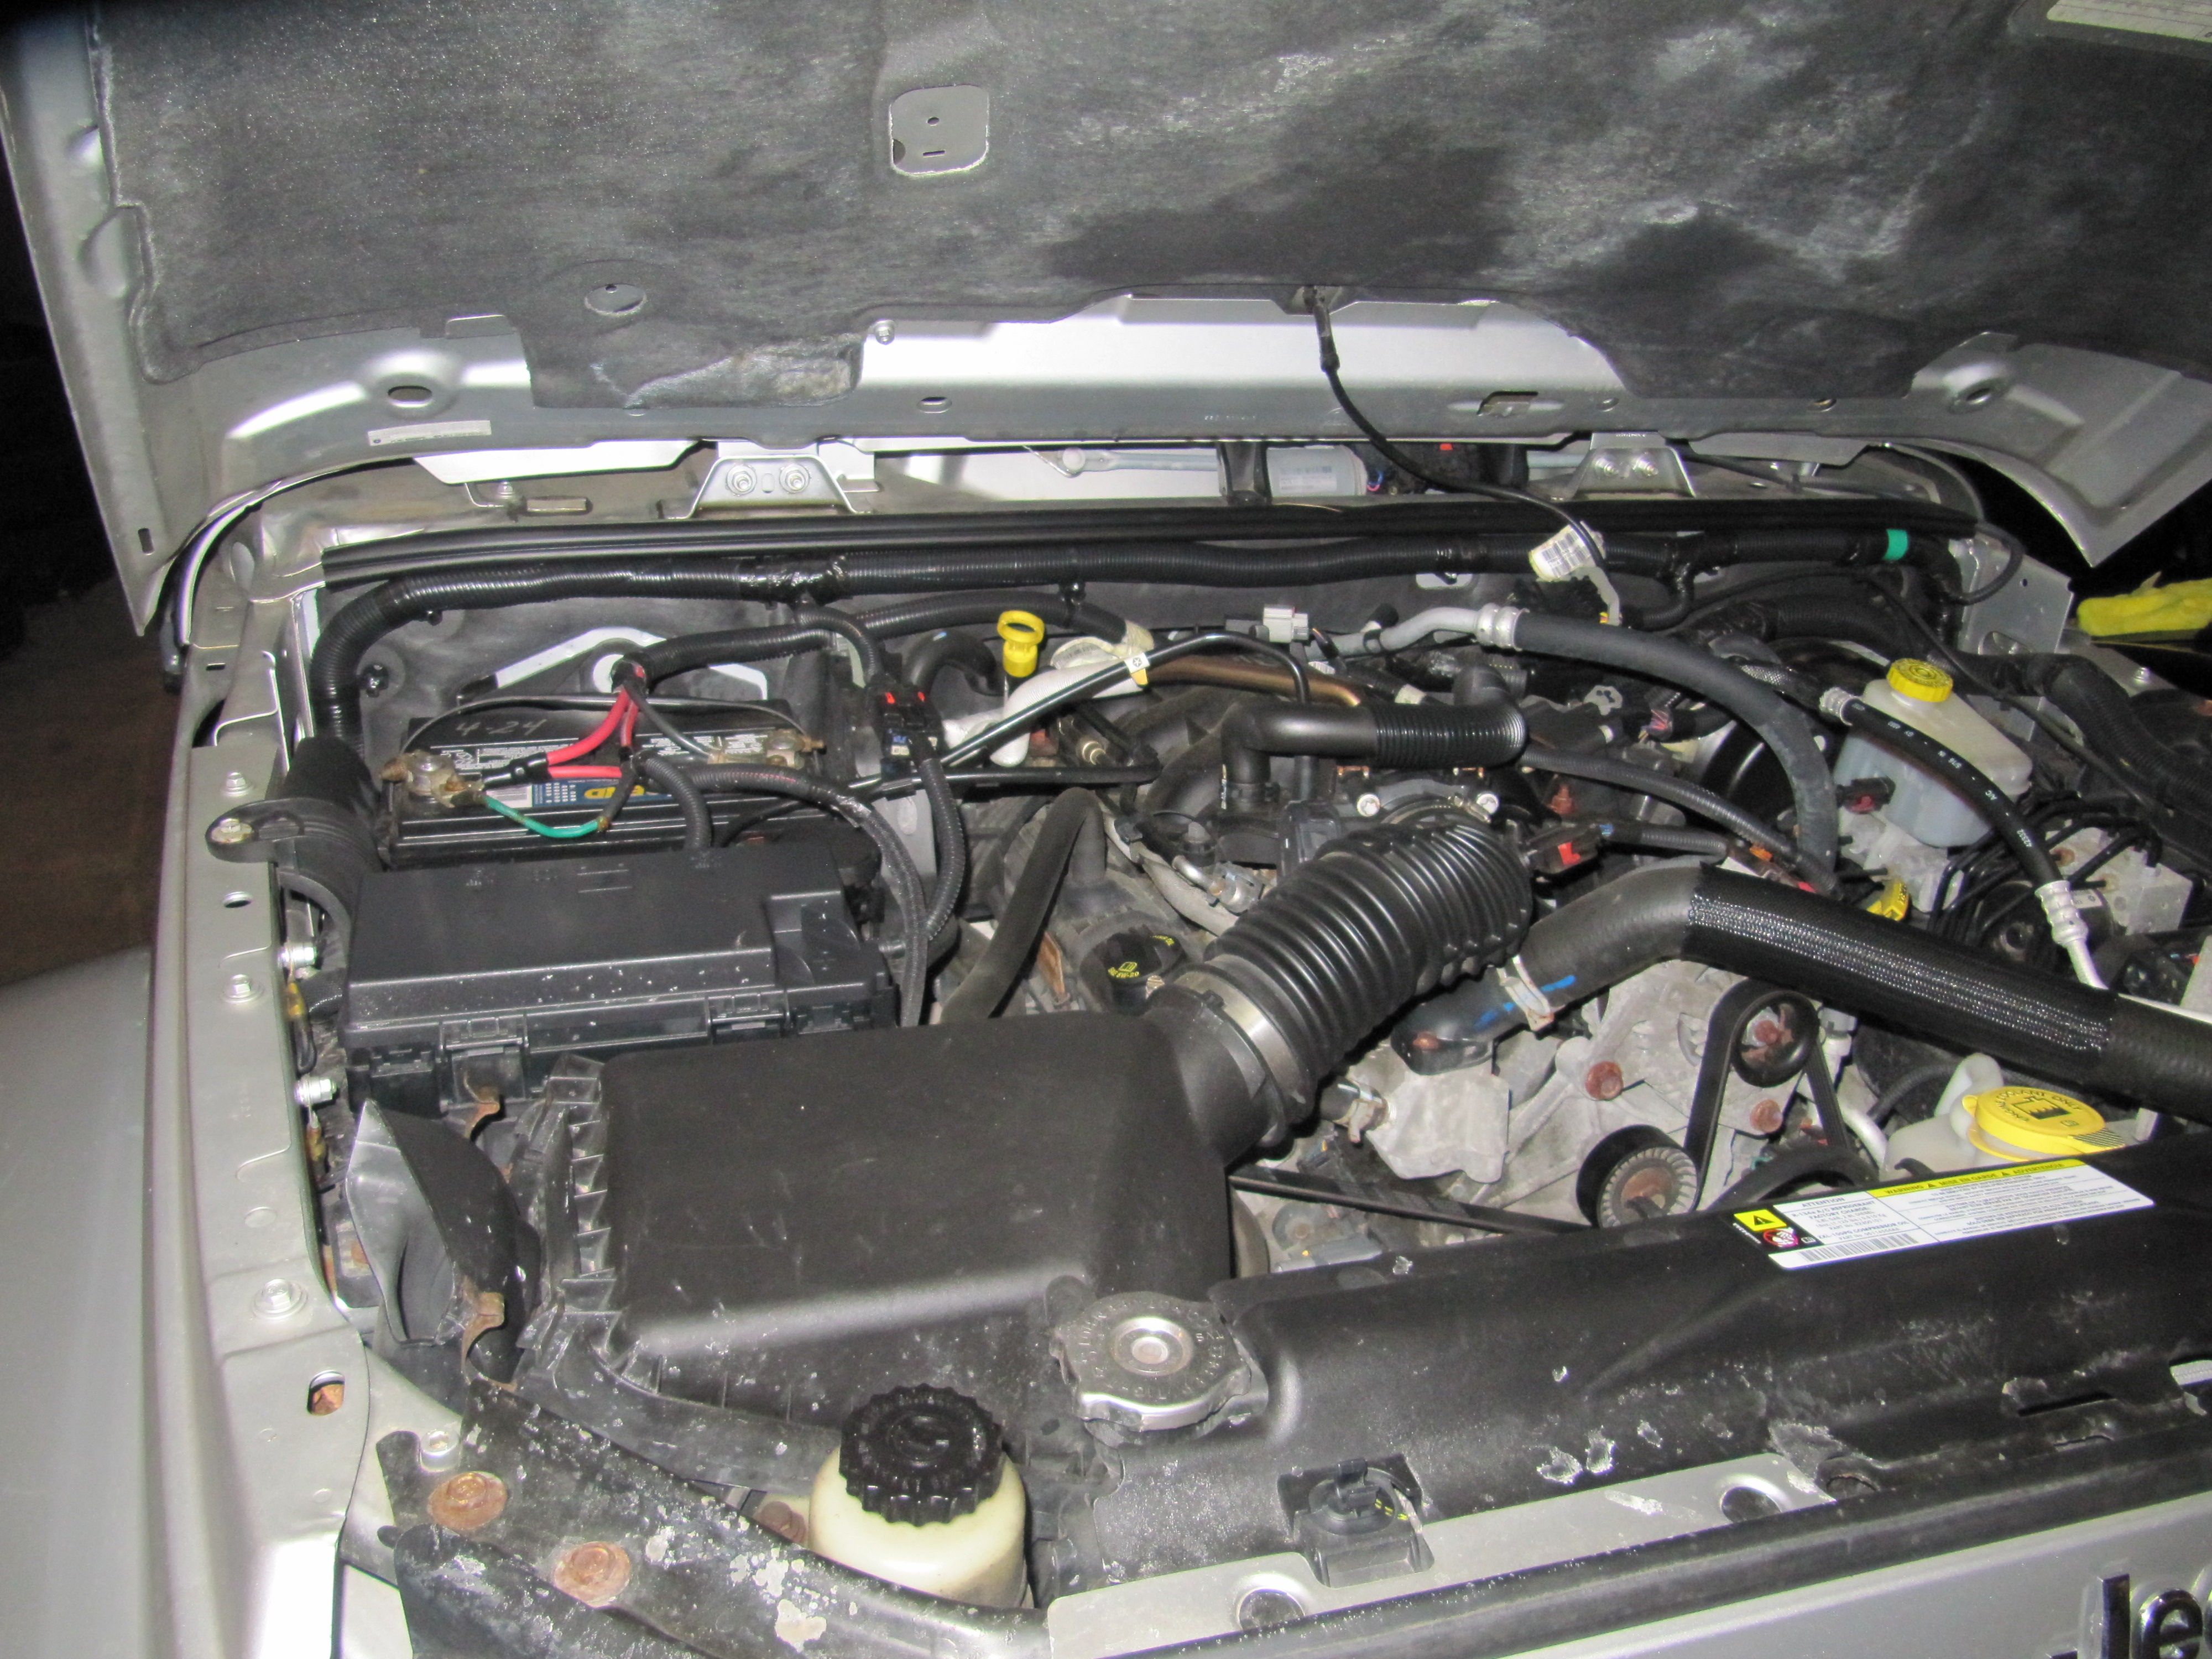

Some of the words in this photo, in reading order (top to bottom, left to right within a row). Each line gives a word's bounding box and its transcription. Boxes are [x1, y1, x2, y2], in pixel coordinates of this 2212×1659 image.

[1985, 790, 1997, 800] A/C
[1996, 1090, 2046, 1101] COOLANT
[2051, 1095, 2082, 1110] ONLY
[1885, 1185, 1925, 1194] WARNING
[2013, 1164, 2064, 1174] ADVERTENCIA
[1802, 1197, 1845, 1208] ATTENTION
[1815, 1207, 1831, 1215] A/C
[1830, 1201, 1876, 1212] REFRIGERANT
[1808, 1211, 1840, 1219] FACTORY
[1853, 1223, 1897, 1233] COMPRESSOR
[2045, 1573, 2212, 1659] Je
